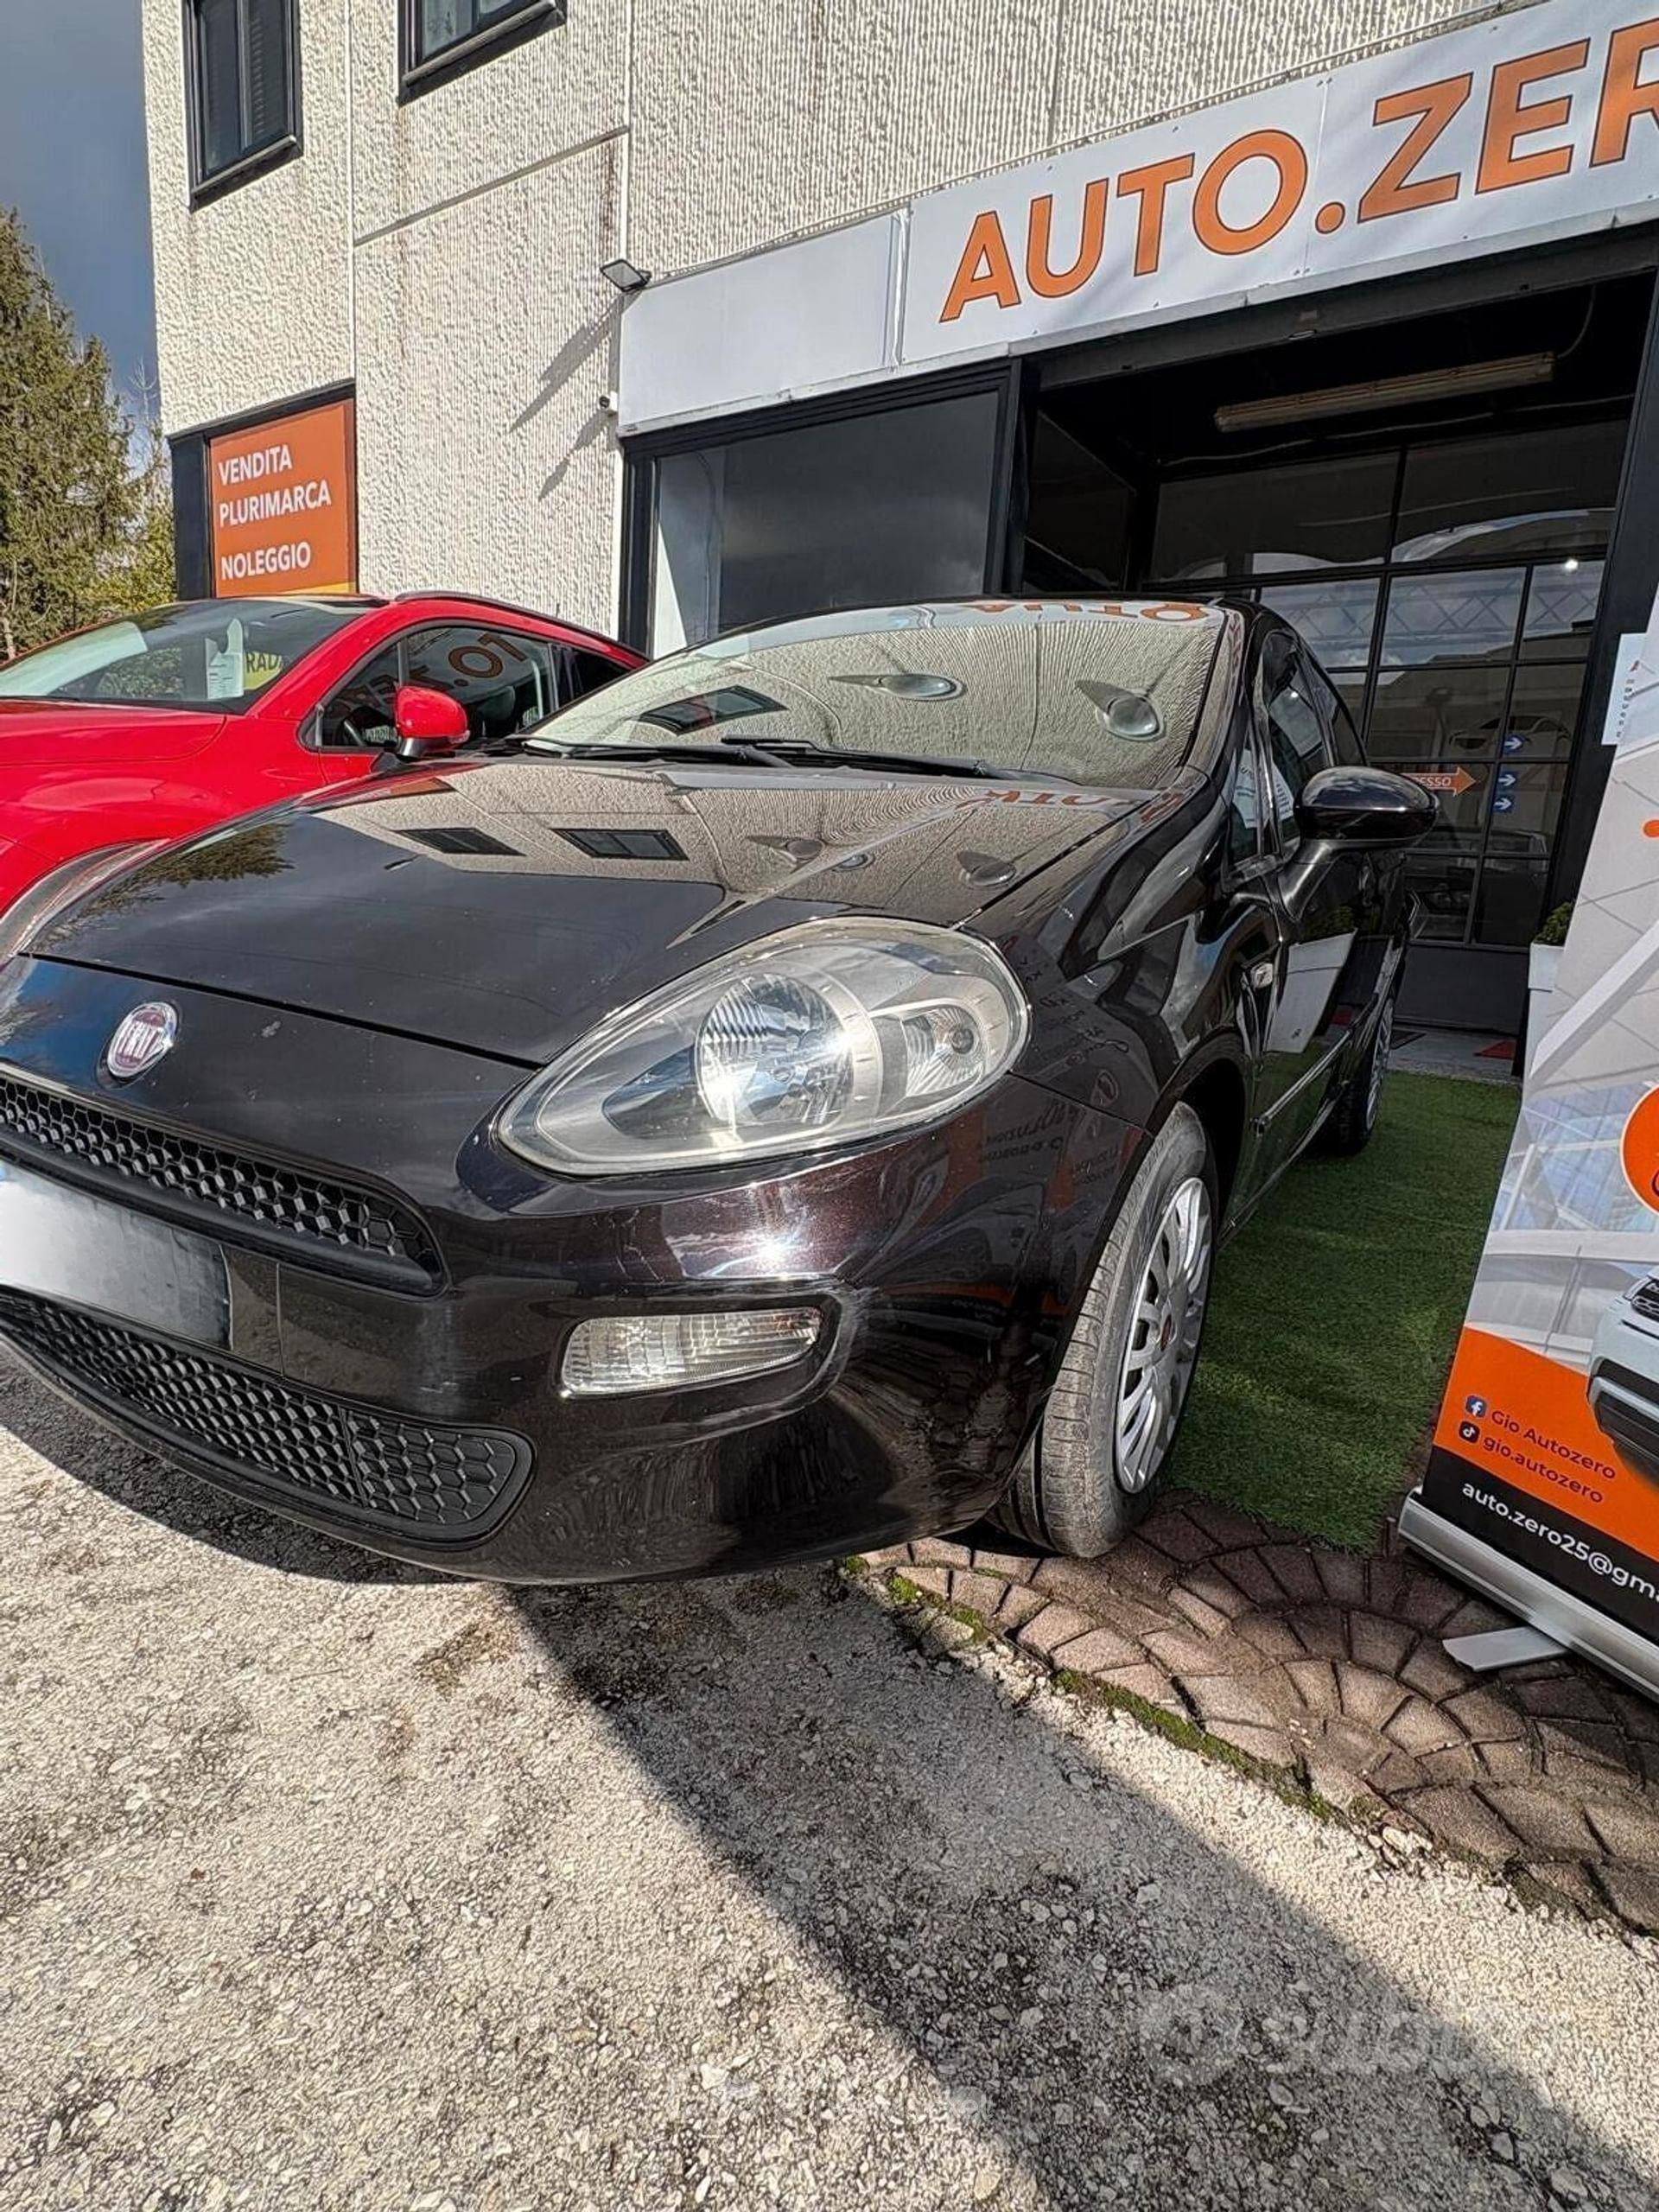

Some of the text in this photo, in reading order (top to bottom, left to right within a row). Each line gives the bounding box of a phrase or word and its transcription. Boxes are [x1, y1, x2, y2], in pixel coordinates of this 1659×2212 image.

[218, 444, 293, 486] VENDITA
[219, 480, 332, 528] PLURIMARCA
[220, 541, 312, 581] NOLEGGIO
[1491, 1410, 1617, 1479] Gio Autozero
[1484, 1436, 1604, 1503] gio.autozero
